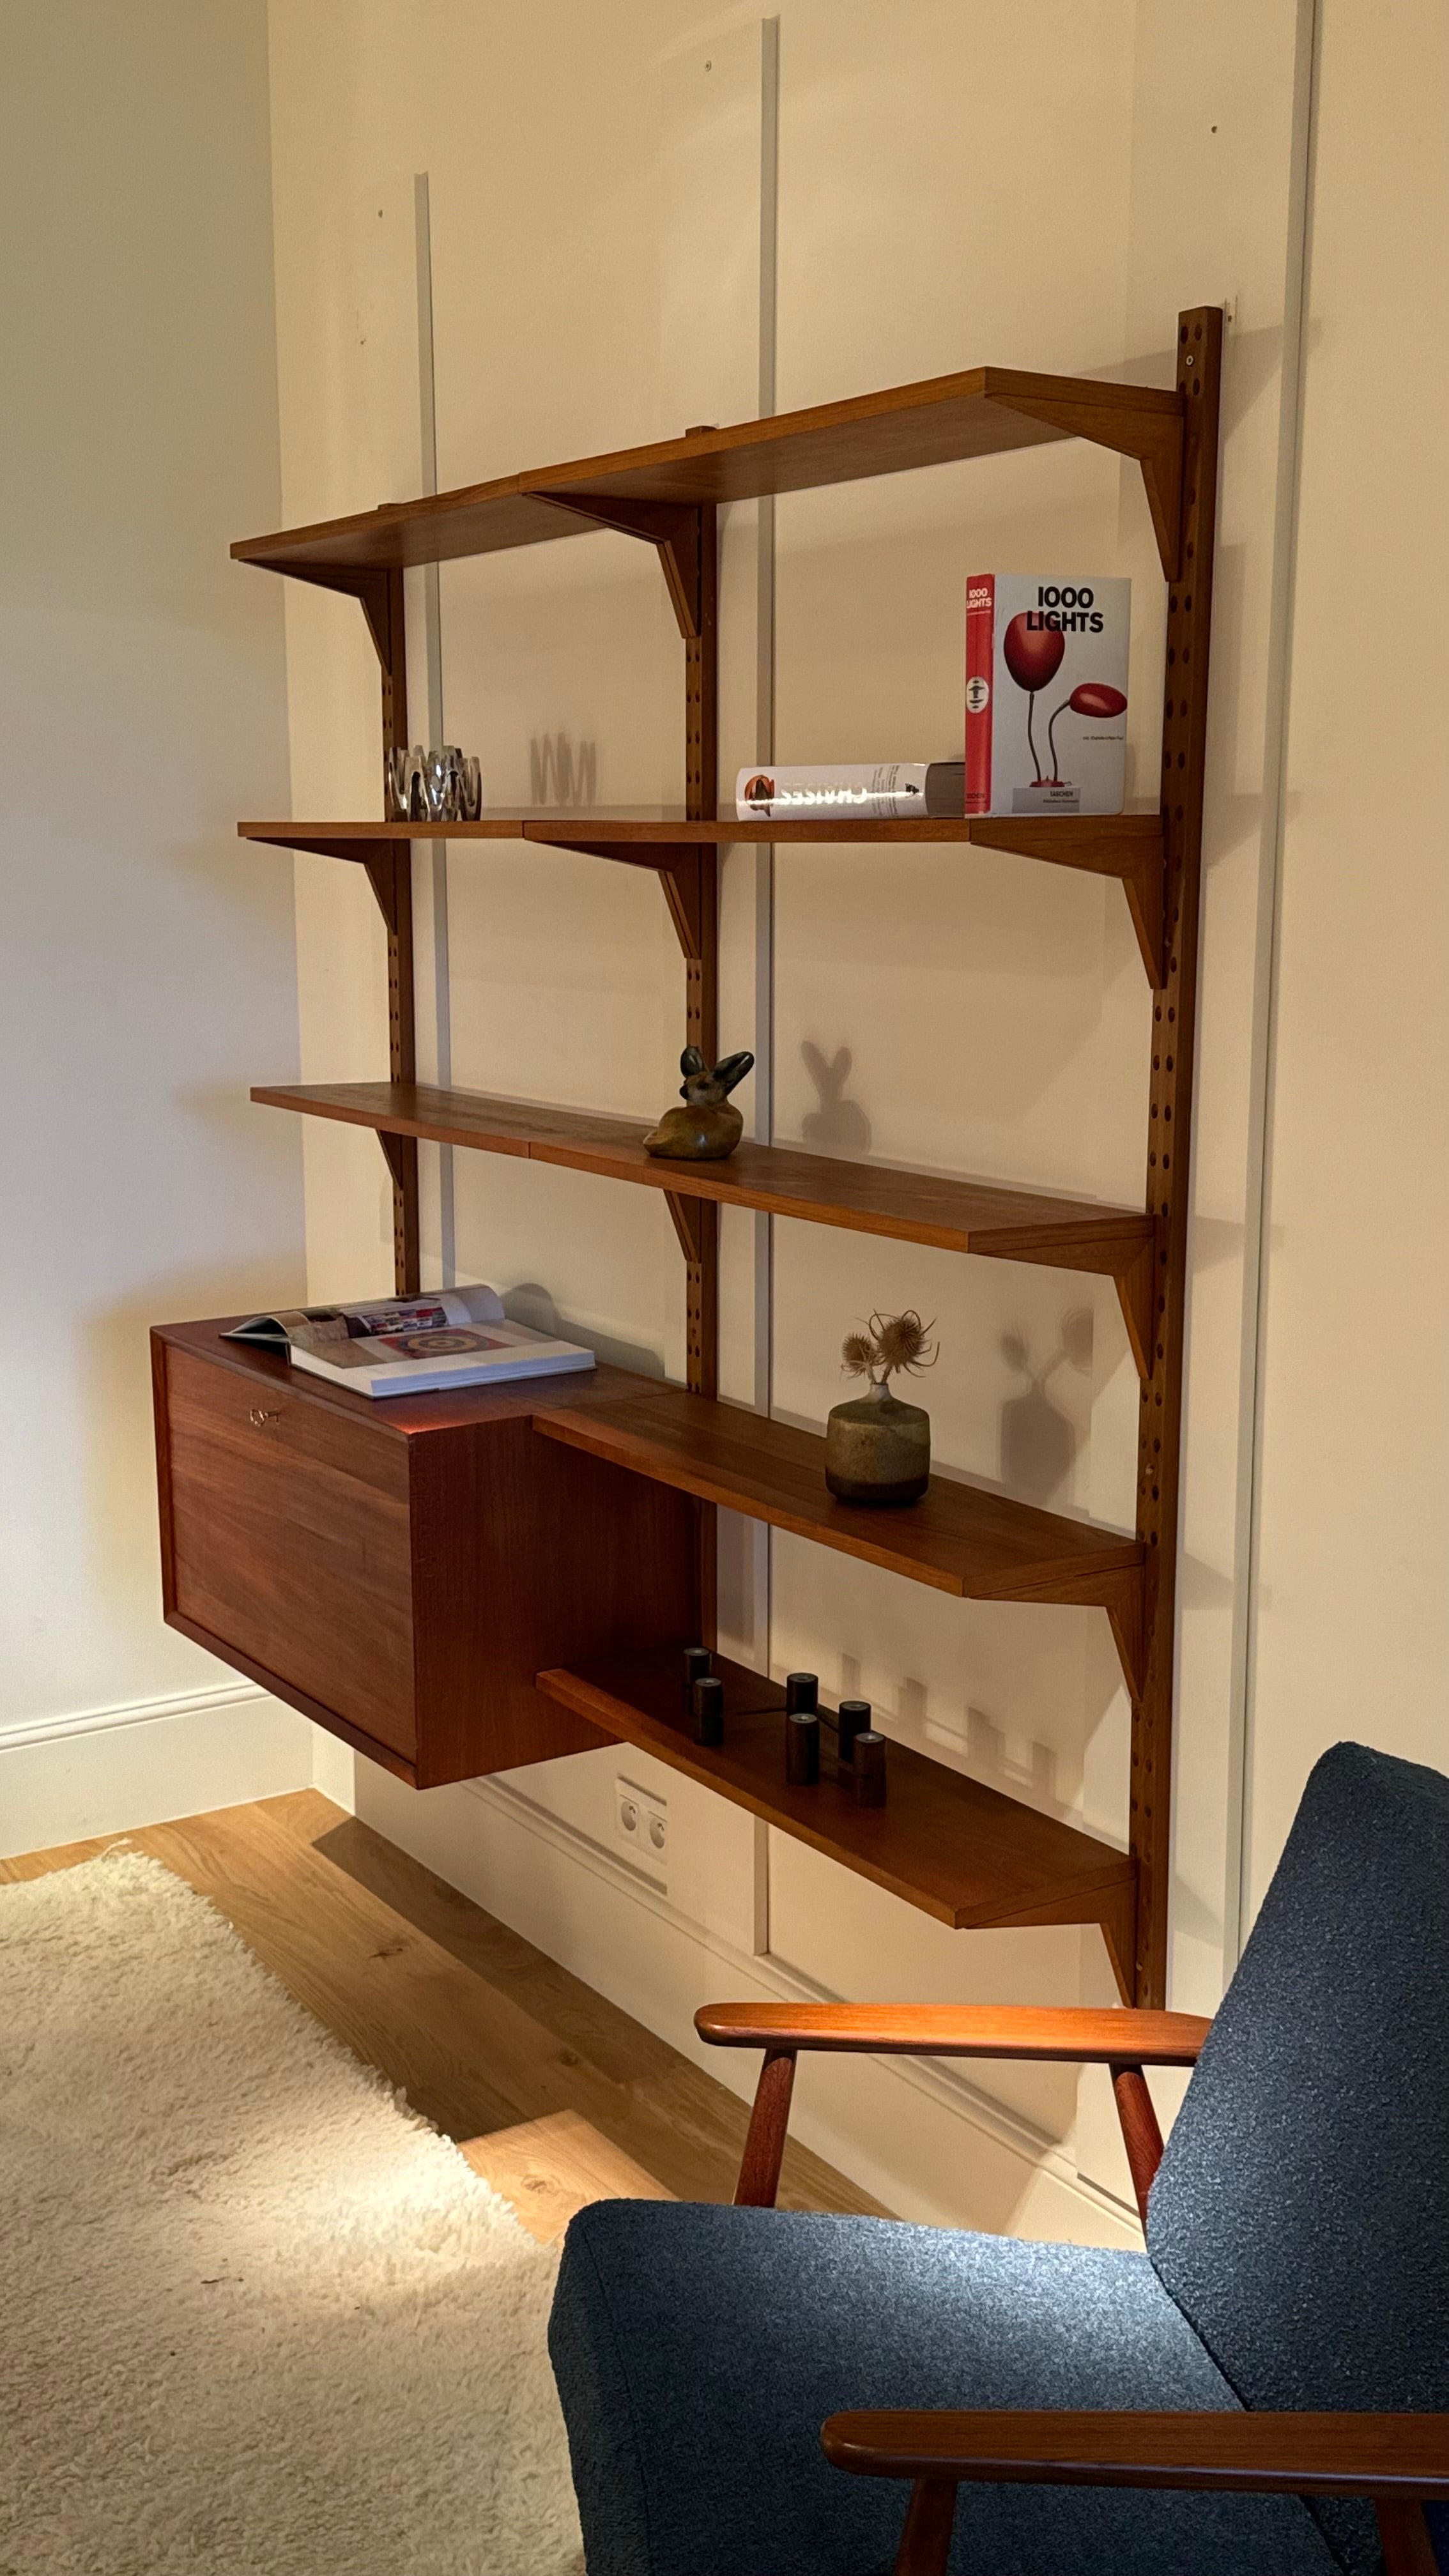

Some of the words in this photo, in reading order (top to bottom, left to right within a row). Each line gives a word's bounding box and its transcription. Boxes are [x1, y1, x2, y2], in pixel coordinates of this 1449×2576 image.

[969, 587, 988, 599] 1000
[1037, 586, 1094, 609] 1000
[966, 597, 992, 609] LIGHTS
[1026, 610, 1104, 633] LIGHTS
